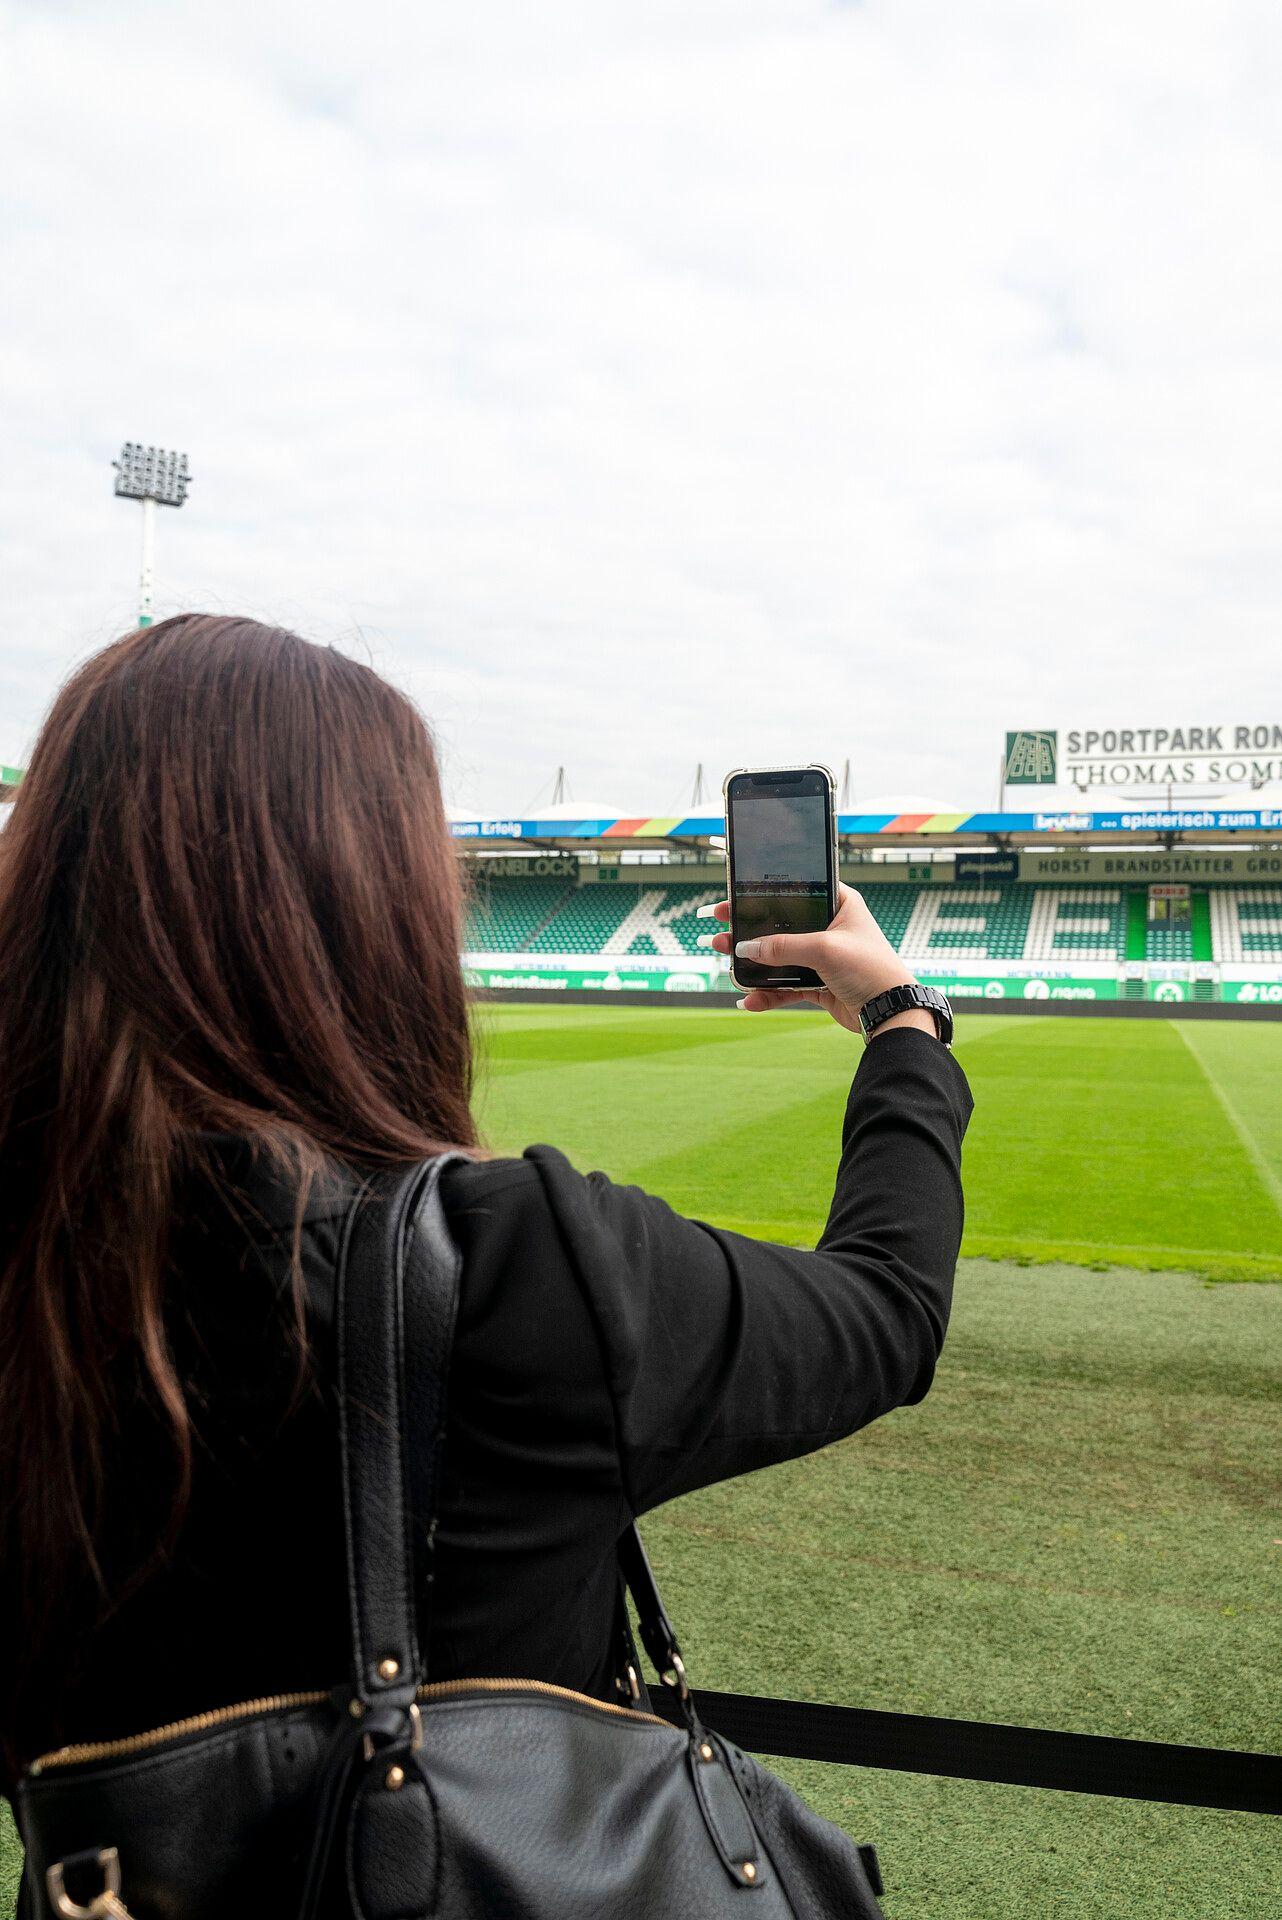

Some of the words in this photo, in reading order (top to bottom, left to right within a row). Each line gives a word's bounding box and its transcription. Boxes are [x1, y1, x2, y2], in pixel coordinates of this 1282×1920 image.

[1067, 727, 1222, 753] SPORTPARK
[1067, 762, 1195, 784] THOMAS
[481, 821, 522, 838] Erfolg
[1121, 811, 1215, 830] spielerisch
[1218, 812, 1256, 827] zum
[1038, 859, 1090, 873] HORST
[1104, 856, 1233, 873] BRANDSTÄTTER
